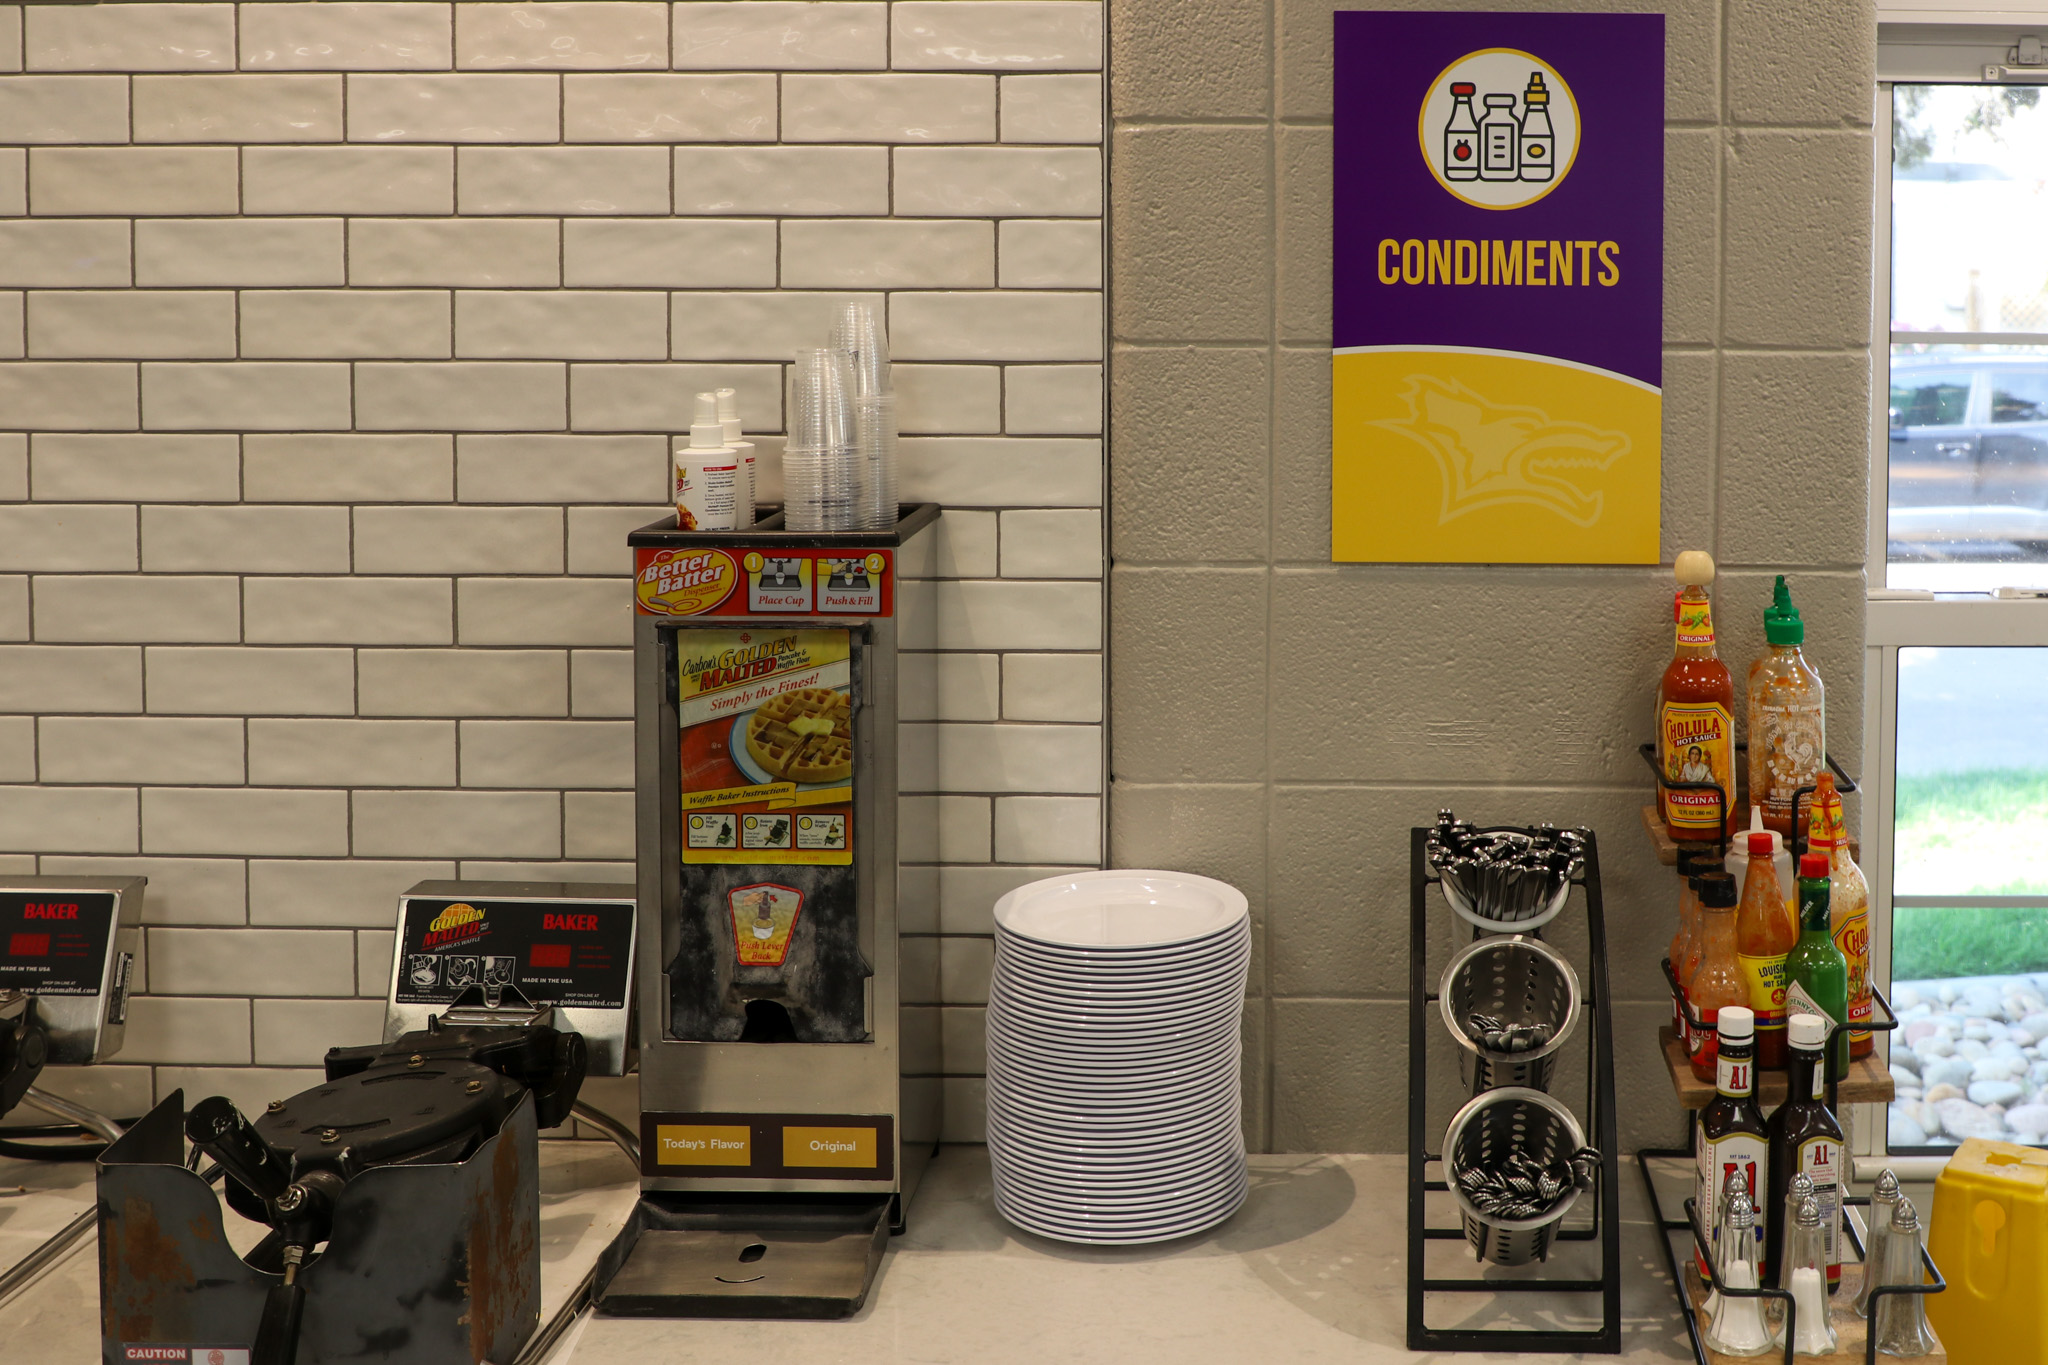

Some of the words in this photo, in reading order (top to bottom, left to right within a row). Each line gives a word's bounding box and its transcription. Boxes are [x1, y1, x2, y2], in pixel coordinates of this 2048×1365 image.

[1377, 238, 1620, 287] CONDIMENTS
[659, 553, 670, 561] The
[751, 556, 757, 569] 1
[870, 558, 880, 569] 2
[642, 552, 714, 585] Better
[656, 565, 726, 596] Batter
[683, 583, 720, 597] Dispenser
[758, 595, 783, 605] Place
[785, 595, 805, 607] Cup
[825, 595, 847, 606] Push
[847, 596, 855, 606] &
[857, 596, 873, 606] Fill
[682, 654, 717, 676] Carbon's
[717, 635, 797, 670] GOLDEN
[777, 652, 801, 663] Pancake
[777, 660, 795, 670] Waffle
[796, 656, 811, 666] Flour
[699, 657, 777, 692] MALTED
[709, 691, 753, 712] Simply
[755, 686, 775, 700] the
[778, 672, 820, 694] Finest!
[1787, 704, 1799, 713] HOT
[1665, 717, 1721, 745] CHOLULA
[1676, 736, 1693, 747] HOT
[1694, 733, 1718, 743] SAUCE
[689, 794, 715, 805] Waffle
[716, 792, 740, 801] Baker
[742, 786, 790, 798] Instructions
[1671, 794, 1721, 804] ORIGINAL
[23, 903, 80, 920] BAKER
[1800, 900, 1815, 919] MILDER
[429, 908, 487, 932] GOLDEN
[542, 913, 599, 931] BAKER
[421, 921, 481, 947] MALTED
[434, 942, 461, 952] AMERICA'S
[461, 937, 481, 946] WAFFLE
[740, 941, 759, 950] Push
[761, 941, 784, 950] Lever
[751, 951, 772, 960] Back
[19, 986, 98, 995] www.goldenmalted.com
[1763, 980, 1774, 988] HOT
[663, 1138, 706, 1151] Today's
[710, 1139, 745, 1150] Flavor
[809, 1139, 856, 1153] Original
[127, 1349, 186, 1359] CAUTION
